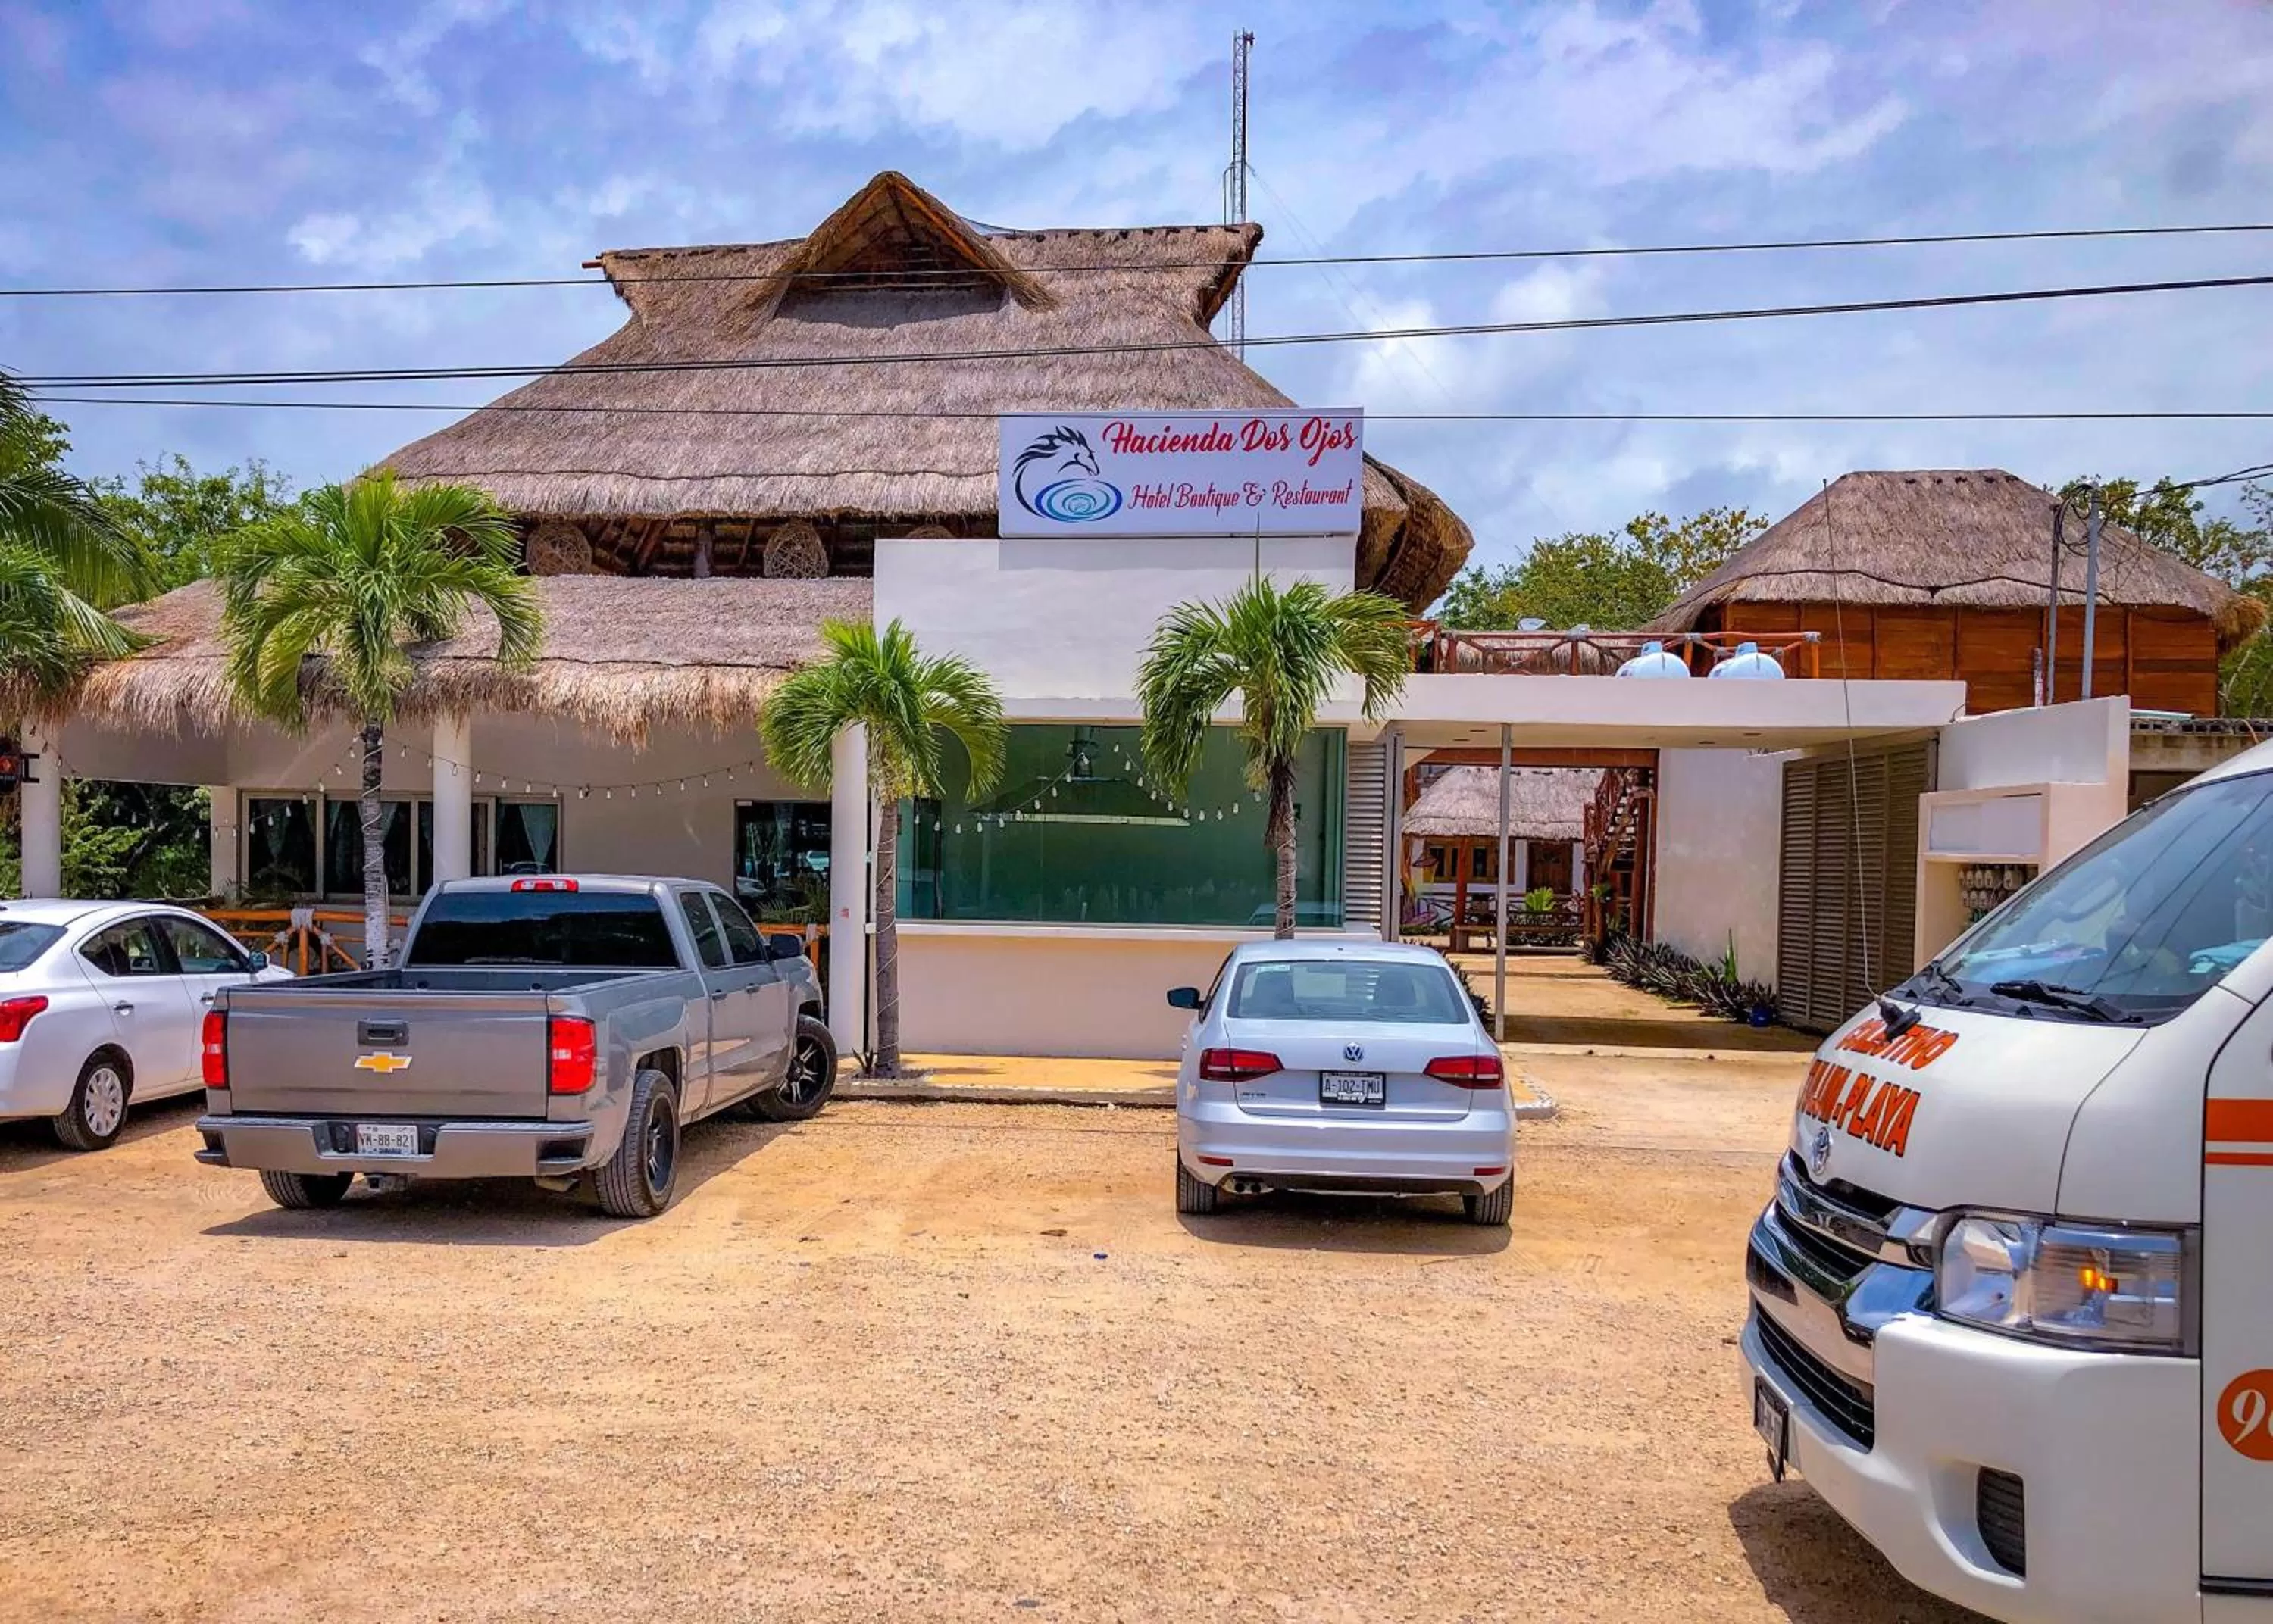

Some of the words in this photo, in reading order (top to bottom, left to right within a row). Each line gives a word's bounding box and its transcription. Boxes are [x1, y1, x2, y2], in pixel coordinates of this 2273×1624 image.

[1103, 421, 1237, 454] Hacienda
[1241, 418, 1293, 453] Dos
[1300, 417, 1358, 467] Ojos
[1127, 482, 1174, 510] Hotel
[1174, 481, 1240, 515] Boutique
[1243, 481, 1267, 507] &
[1272, 478, 1353, 509] Restaurant
[2231, 1388, 2273, 1445] 9
